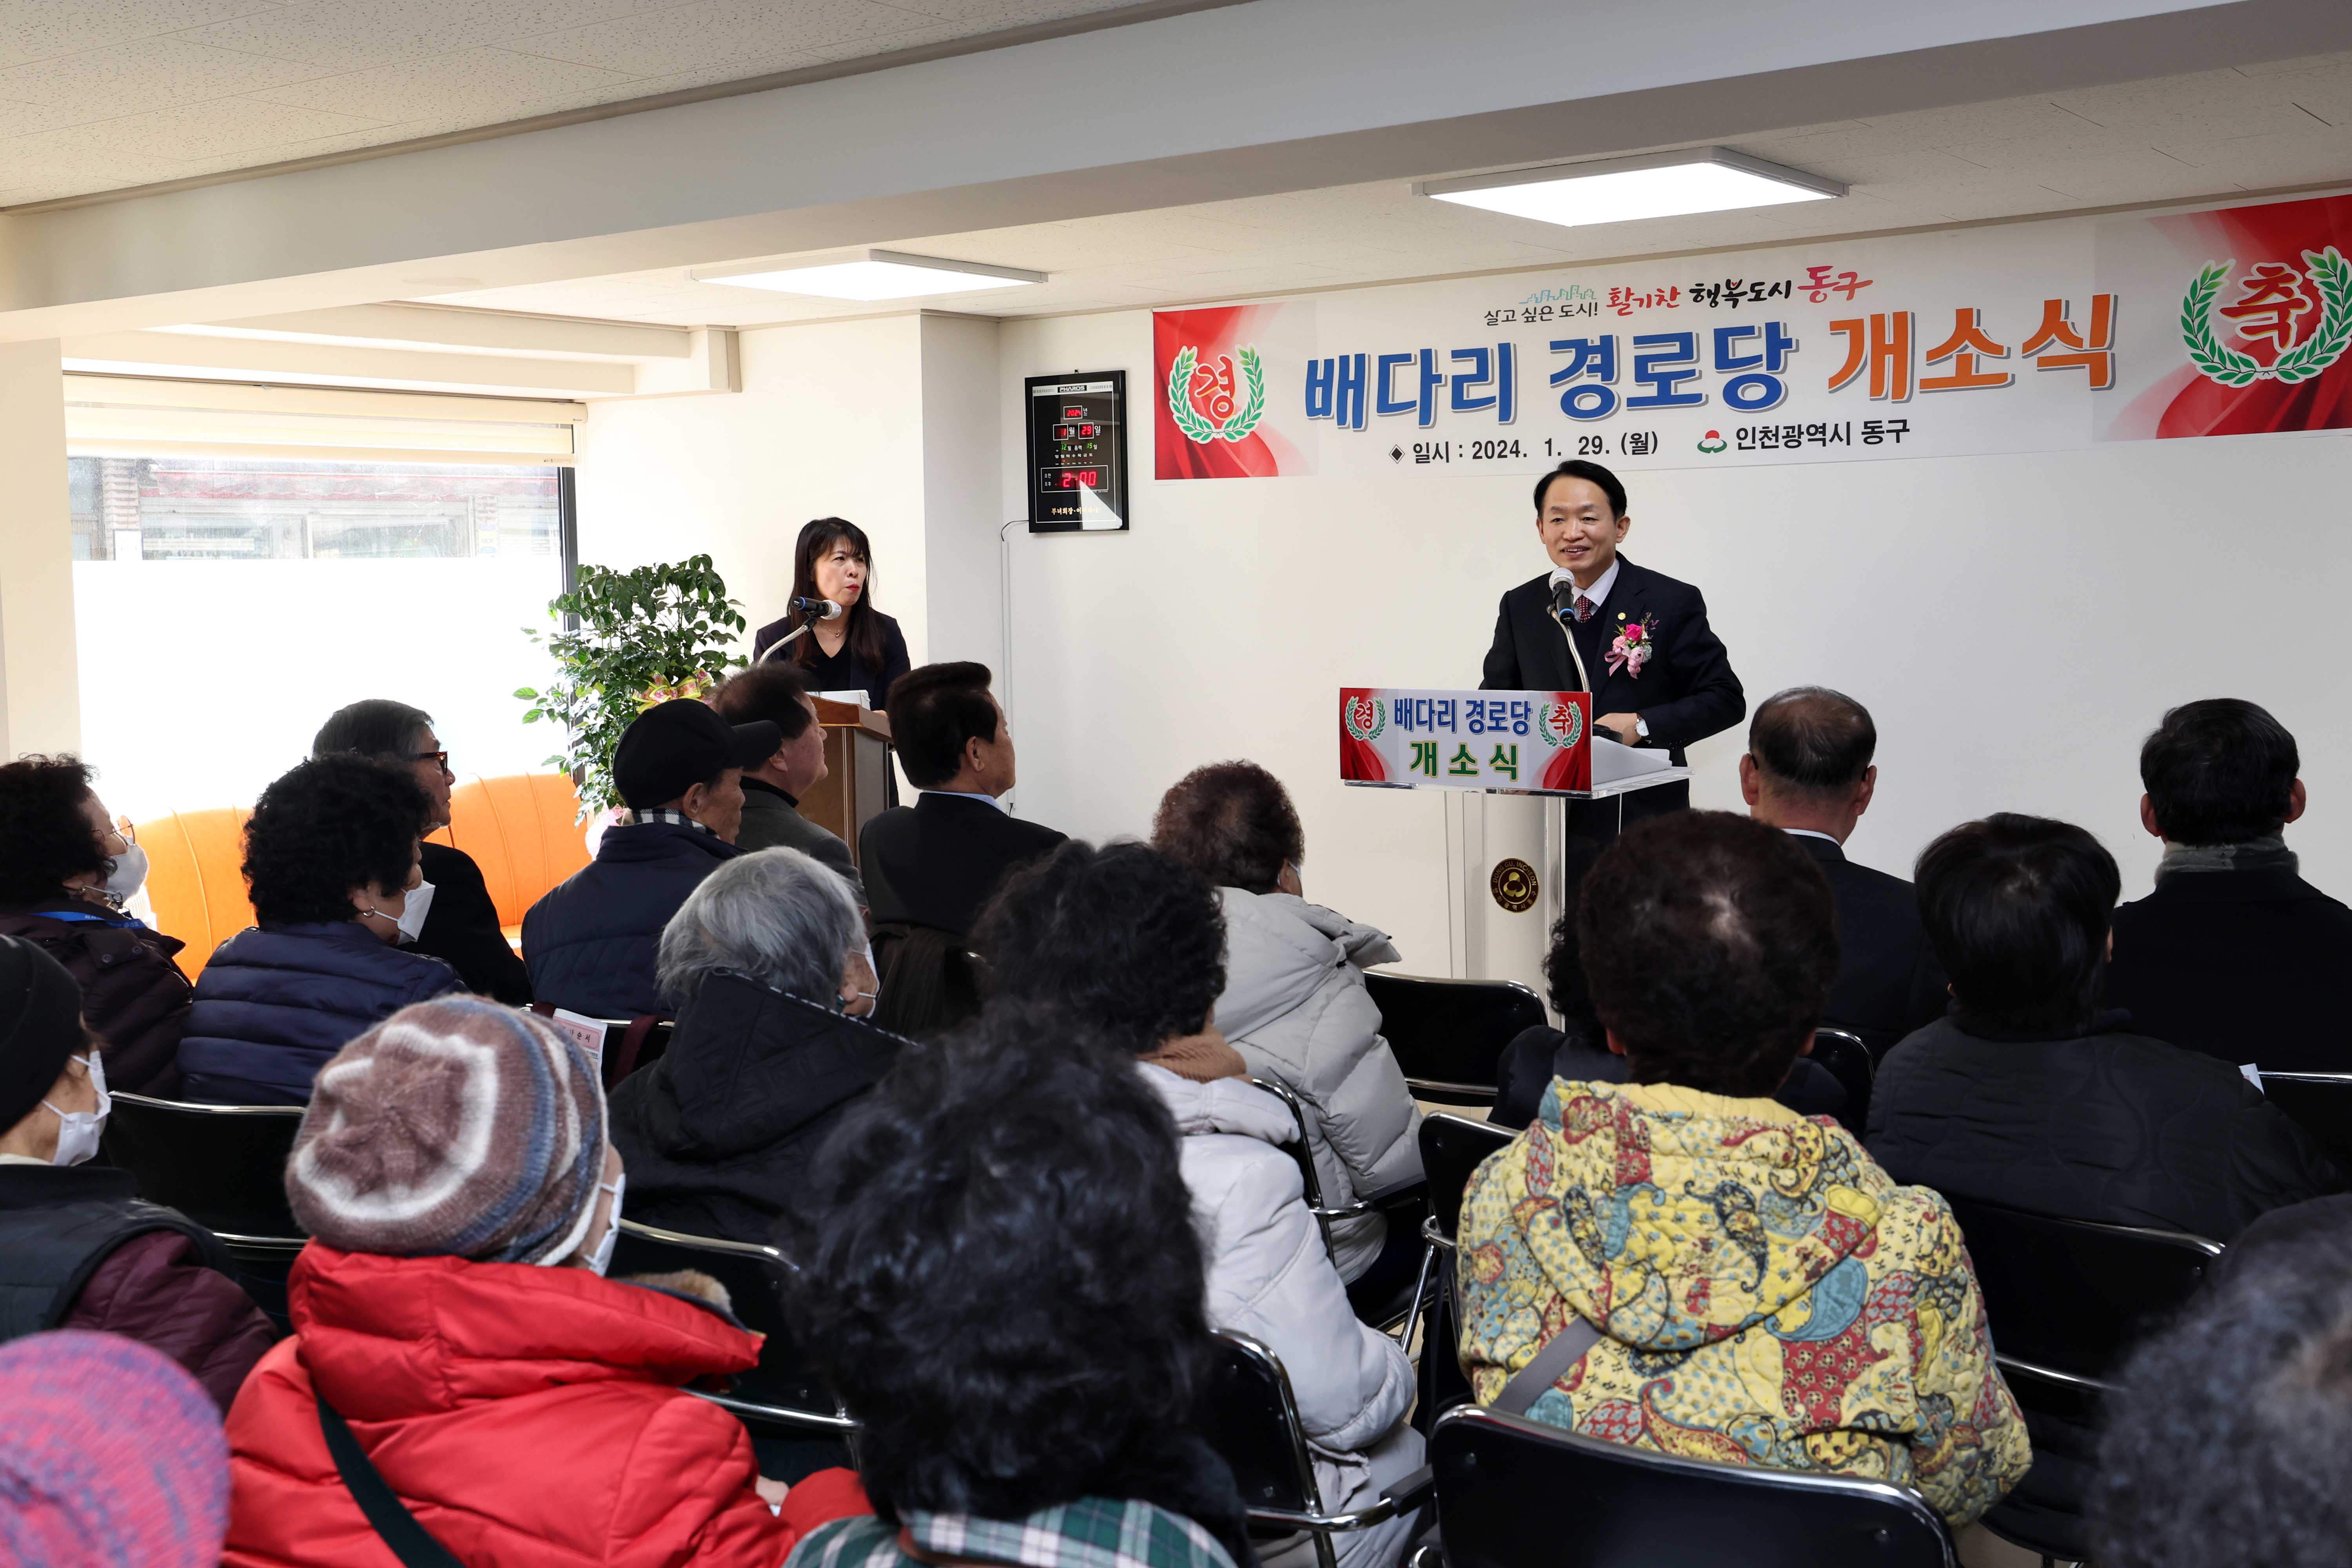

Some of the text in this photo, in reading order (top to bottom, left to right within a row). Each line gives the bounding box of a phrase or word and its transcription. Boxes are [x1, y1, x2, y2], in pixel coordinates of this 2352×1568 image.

[1484, 265, 1873, 326] 살고 싶은 도시! 활기찬 행복도시 동구
[2220, 265, 2307, 350] 축
[1305, 294, 2117, 430] 배다리 경로당 개소식
[1195, 355, 1236, 420] 경
[1082, 426, 1092, 435] 29
[1736, 419, 1910, 450] 인천광역시 동구
[1413, 441, 1450, 464] 일시
[1472, 439, 1527, 460] 2024.
[1544, 438, 1561, 456] 1.
[1578, 436, 1610, 455] 29.
[1621, 431, 1658, 456] (월)
[1355, 700, 1372, 730] 경
[1394, 698, 1533, 735] 배다리 경로당
[1549, 706, 1573, 736] 축
[1492, 865, 1504, 883] DONG
[1517, 862, 1537, 886] INCHEON
